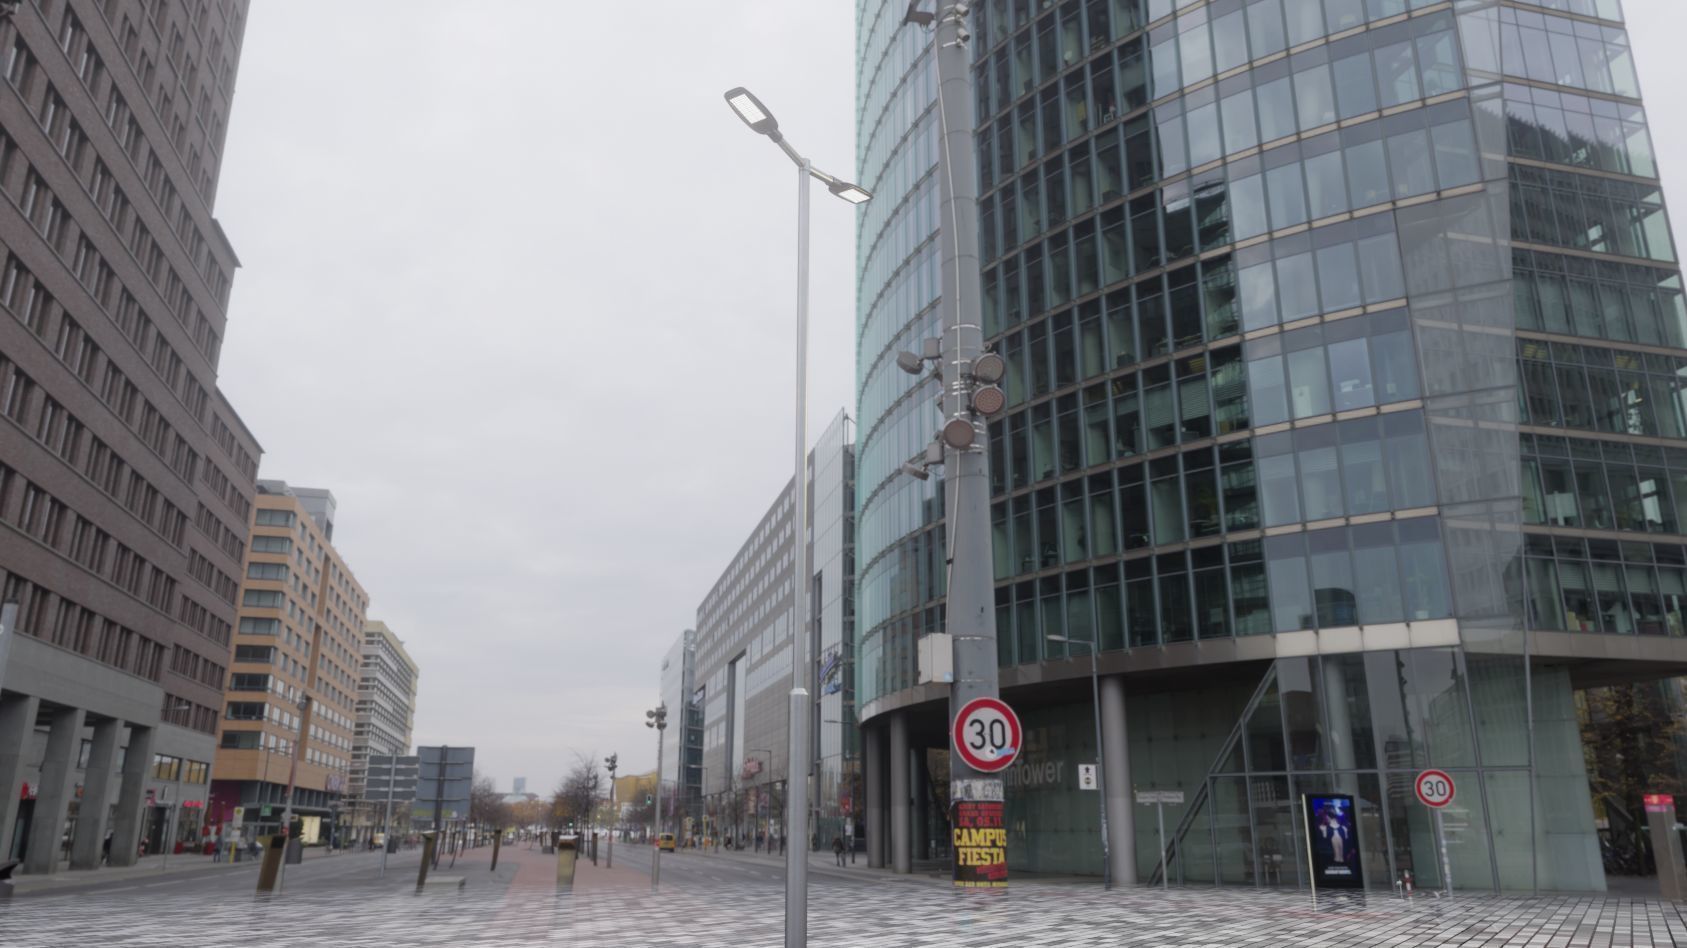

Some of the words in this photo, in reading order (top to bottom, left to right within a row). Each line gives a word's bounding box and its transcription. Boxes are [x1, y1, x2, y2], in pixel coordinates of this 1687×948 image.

[969, 718, 1006, 750] 30
[1424, 780, 1446, 797] 30
[953, 828, 1007, 847] CAMPUS
[958, 847, 1006, 866] FIESTA
